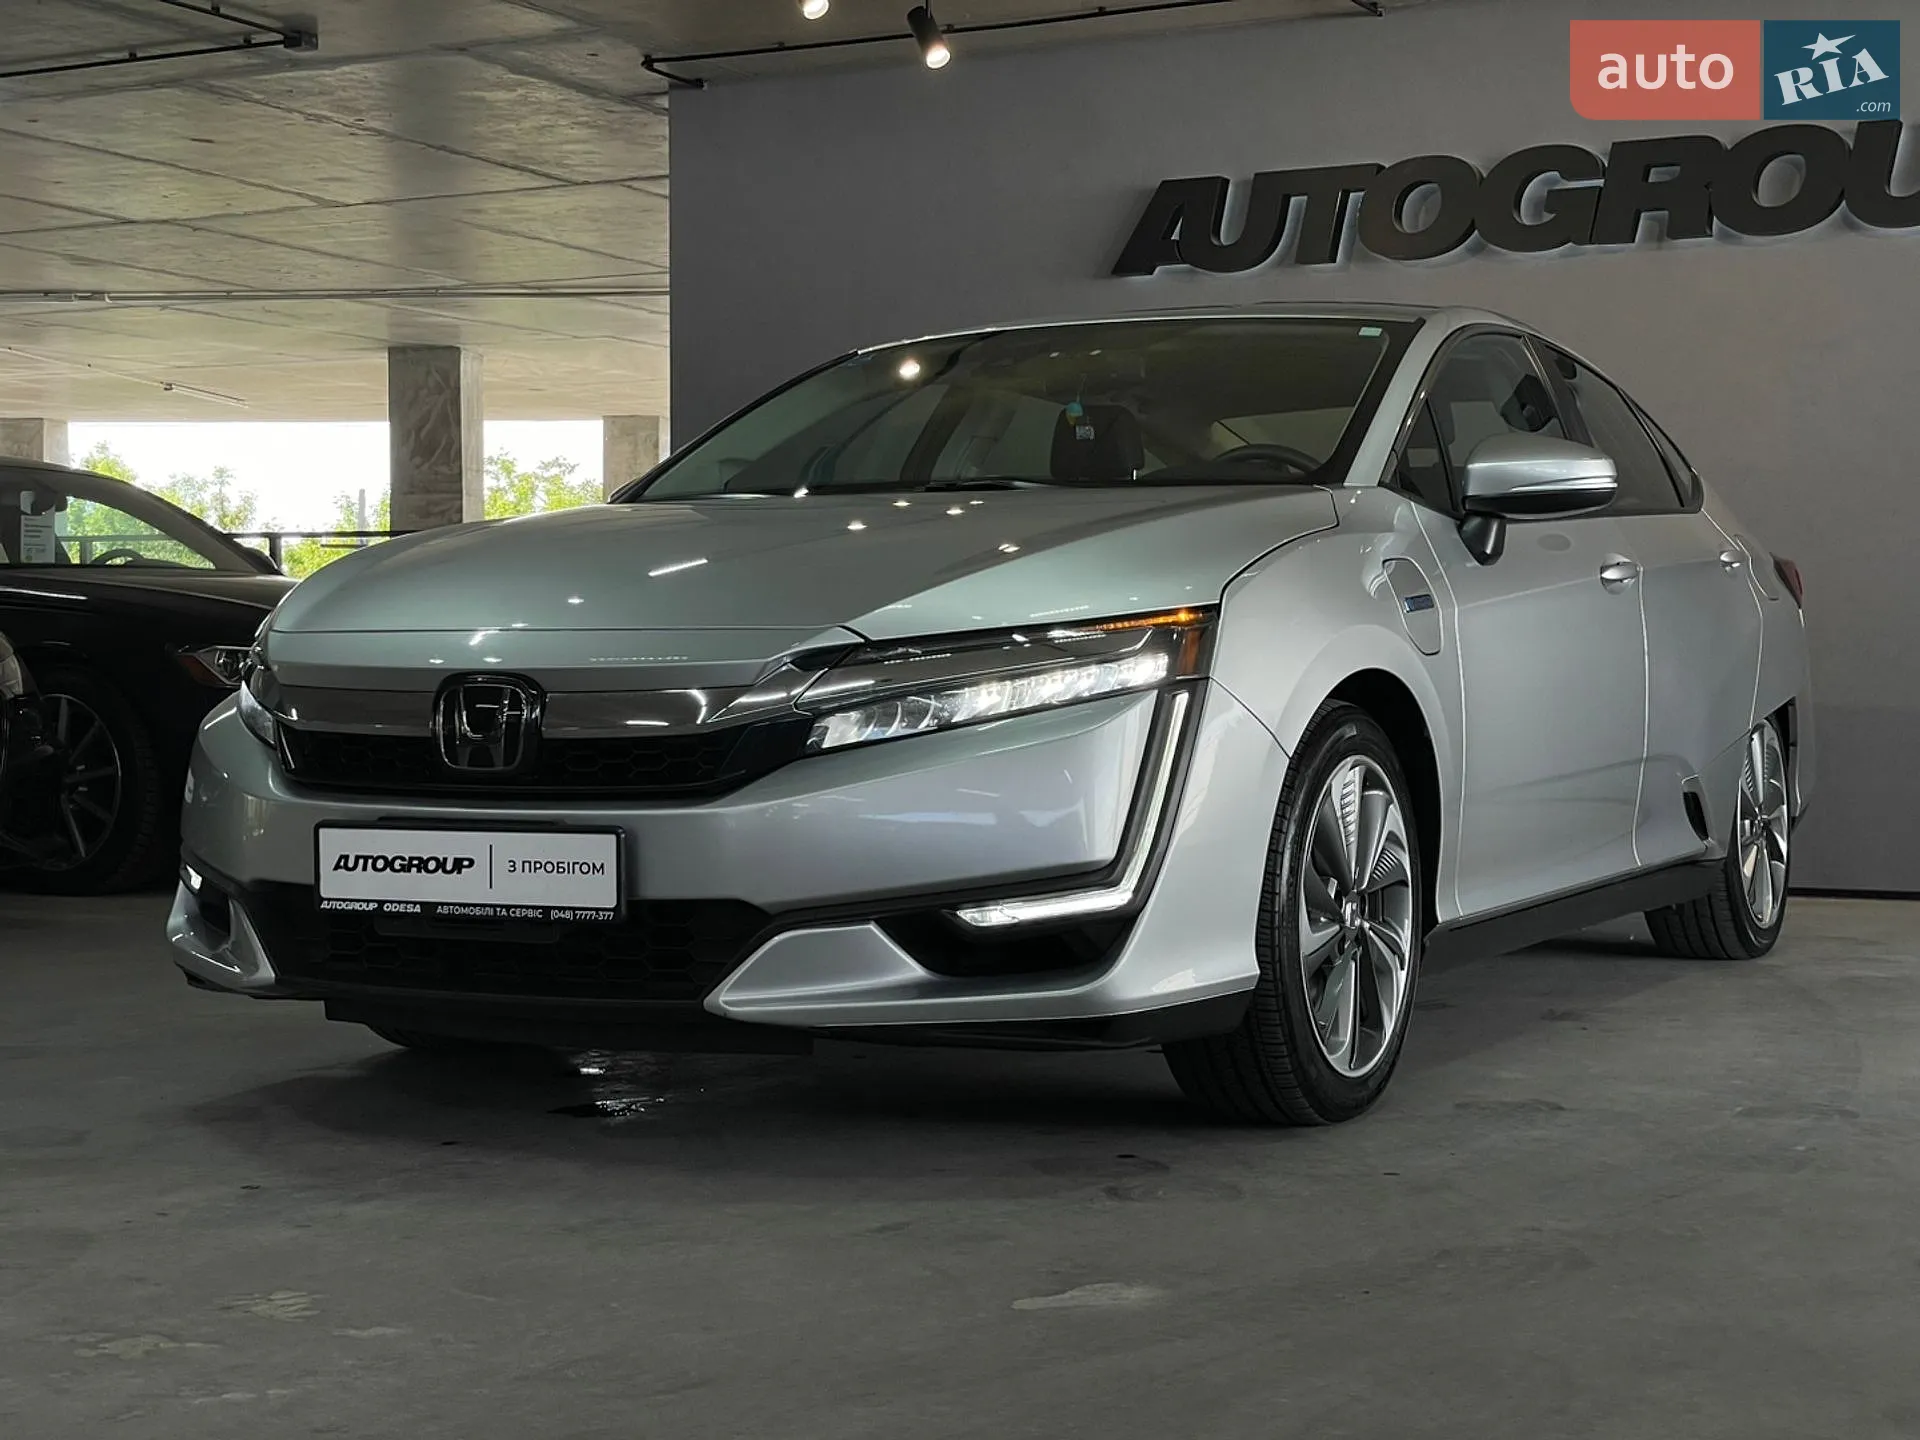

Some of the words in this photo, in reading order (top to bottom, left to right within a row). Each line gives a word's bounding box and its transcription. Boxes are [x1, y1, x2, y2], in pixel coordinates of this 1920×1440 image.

[332, 854, 475, 875] AUTOGROUP
[521, 861, 605, 876] ПРОБІГОМ
[320, 900, 378, 911] AUTOGROUP
[383, 902, 421, 913] ODESA
[436, 905, 494, 916] АВТОМОБІЛІ
[496, 907, 508, 917] ТА
[509, 908, 543, 918] СЕРВІС
